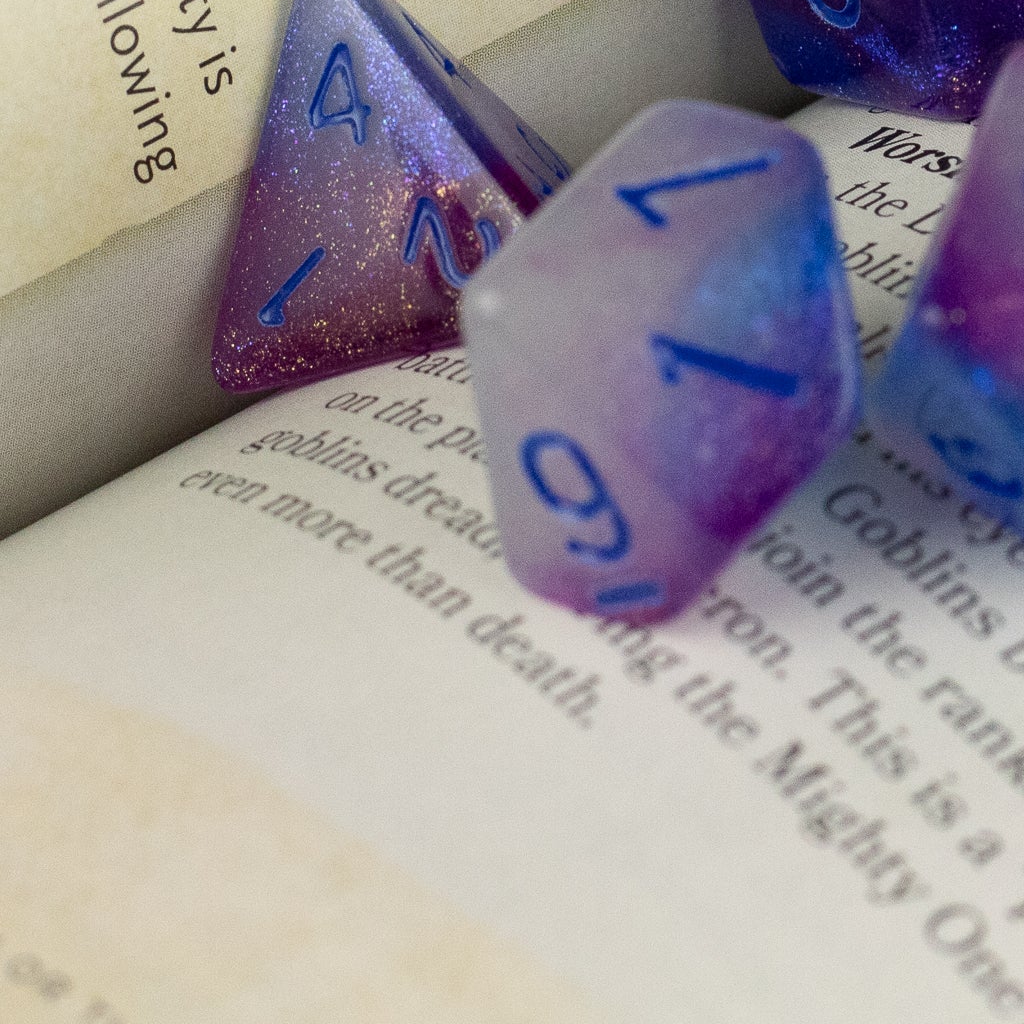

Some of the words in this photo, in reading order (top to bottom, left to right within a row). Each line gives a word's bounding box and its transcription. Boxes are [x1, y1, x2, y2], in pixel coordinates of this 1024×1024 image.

[199, 45, 236, 96] is
[309, 41, 372, 146] 4
[848, 126, 963, 179] Wors
[834, 180, 909, 218] the
[323, 390, 376, 416] on
[372, 396, 444, 436] the
[239, 425, 391, 487] goblins
[178, 463, 269, 512] even
[262, 488, 374, 558] more
[366, 542, 475, 622] than
[466, 612, 606, 731] death.
[821, 480, 1005, 644] Goblins
[841, 602, 929, 679] the
[672, 673, 761, 752] the
[750, 738, 933, 909] Mighty
[805, 668, 918, 784] This
[908, 771, 970, 834] is
[957, 828, 1005, 870] a
